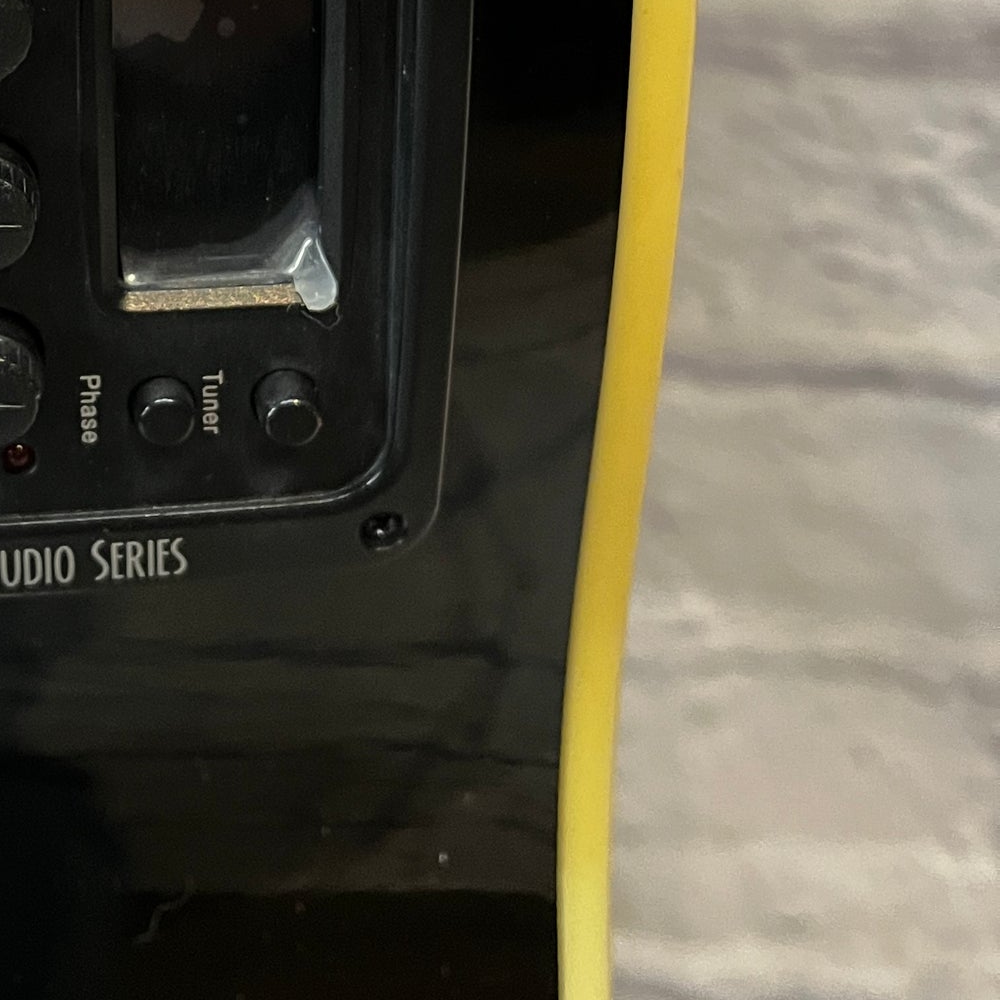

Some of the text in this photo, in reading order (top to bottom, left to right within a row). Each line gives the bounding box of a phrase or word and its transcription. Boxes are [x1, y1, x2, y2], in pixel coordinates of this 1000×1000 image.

[79, 374, 102, 444] Phase
[201, 369, 224, 435] Tuner
[90, 537, 188, 581] SERIES
